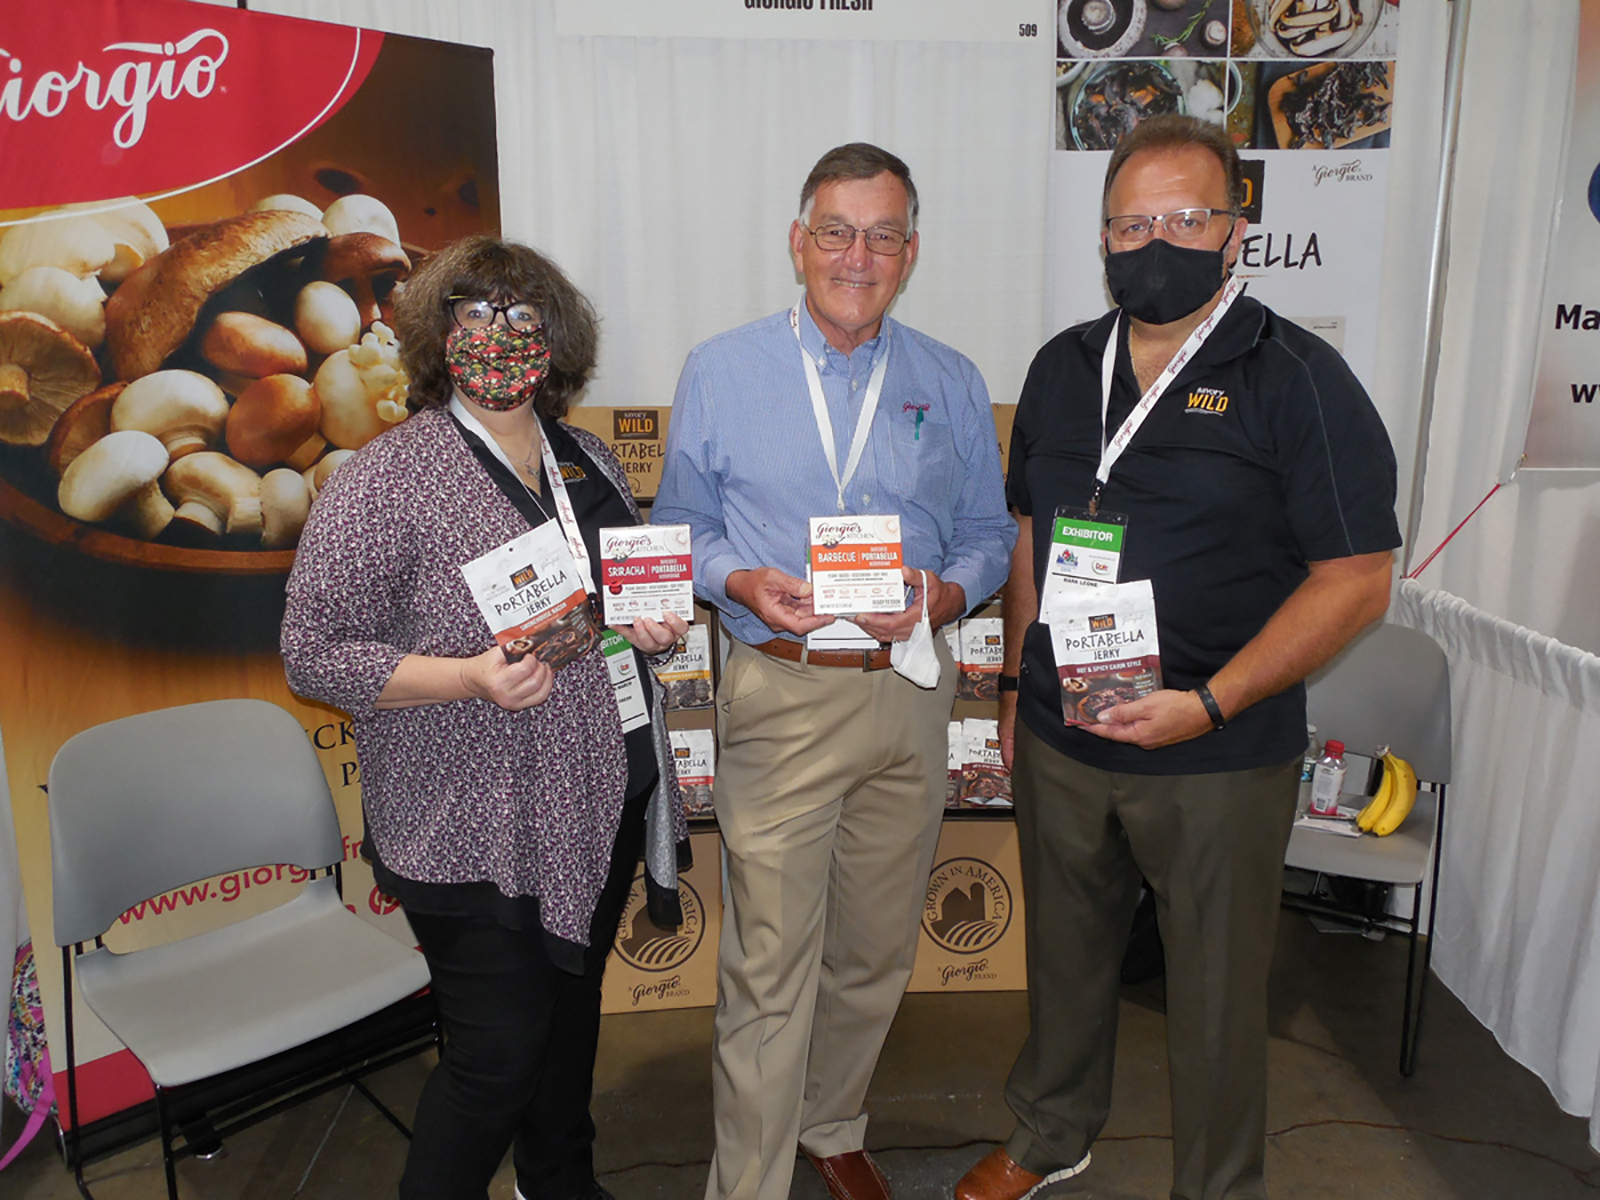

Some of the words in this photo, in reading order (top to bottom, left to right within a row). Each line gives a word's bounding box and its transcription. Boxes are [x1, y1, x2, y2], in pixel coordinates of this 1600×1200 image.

[1019, 23, 1038, 37] 509
[0, 28, 229, 149] iorgio
[1314, 159, 1361, 187] Giorgio
[1345, 174, 1373, 182] BRAND
[1241, 232, 1322, 270] ELLA
[1187, 392, 1229, 412] WILD
[1571, 383, 1600, 404] w
[618, 418, 654, 433] WILD
[611, 442, 665, 460] RTABEL
[816, 521, 862, 539] Giorgio's
[1062, 525, 1113, 542] EXHIBITOR
[605, 535, 652, 553] Giorgio's
[818, 551, 856, 563] BARBECUE
[513, 568, 535, 585] WILD
[607, 565, 646, 578] SRIRACHA
[494, 569, 568, 616] PORTABELLA
[526, 595, 552, 616] JERKY
[1091, 617, 1113, 629] WILD
[1065, 629, 1145, 651] PORTABELLA
[1093, 647, 1120, 660] JERKY
[1092, 665, 1108, 673] SPICY
[1126, 660, 1142, 668] STYLE
[926, 872, 949, 922] GROWN
[950, 865, 962, 876] IN
[965, 865, 1005, 920] AMERICA
[678, 890, 698, 936] ERICA
[941, 957, 989, 987] Giorgio
[631, 974, 682, 1007] Giorgio
[665, 989, 690, 998] BRAND
